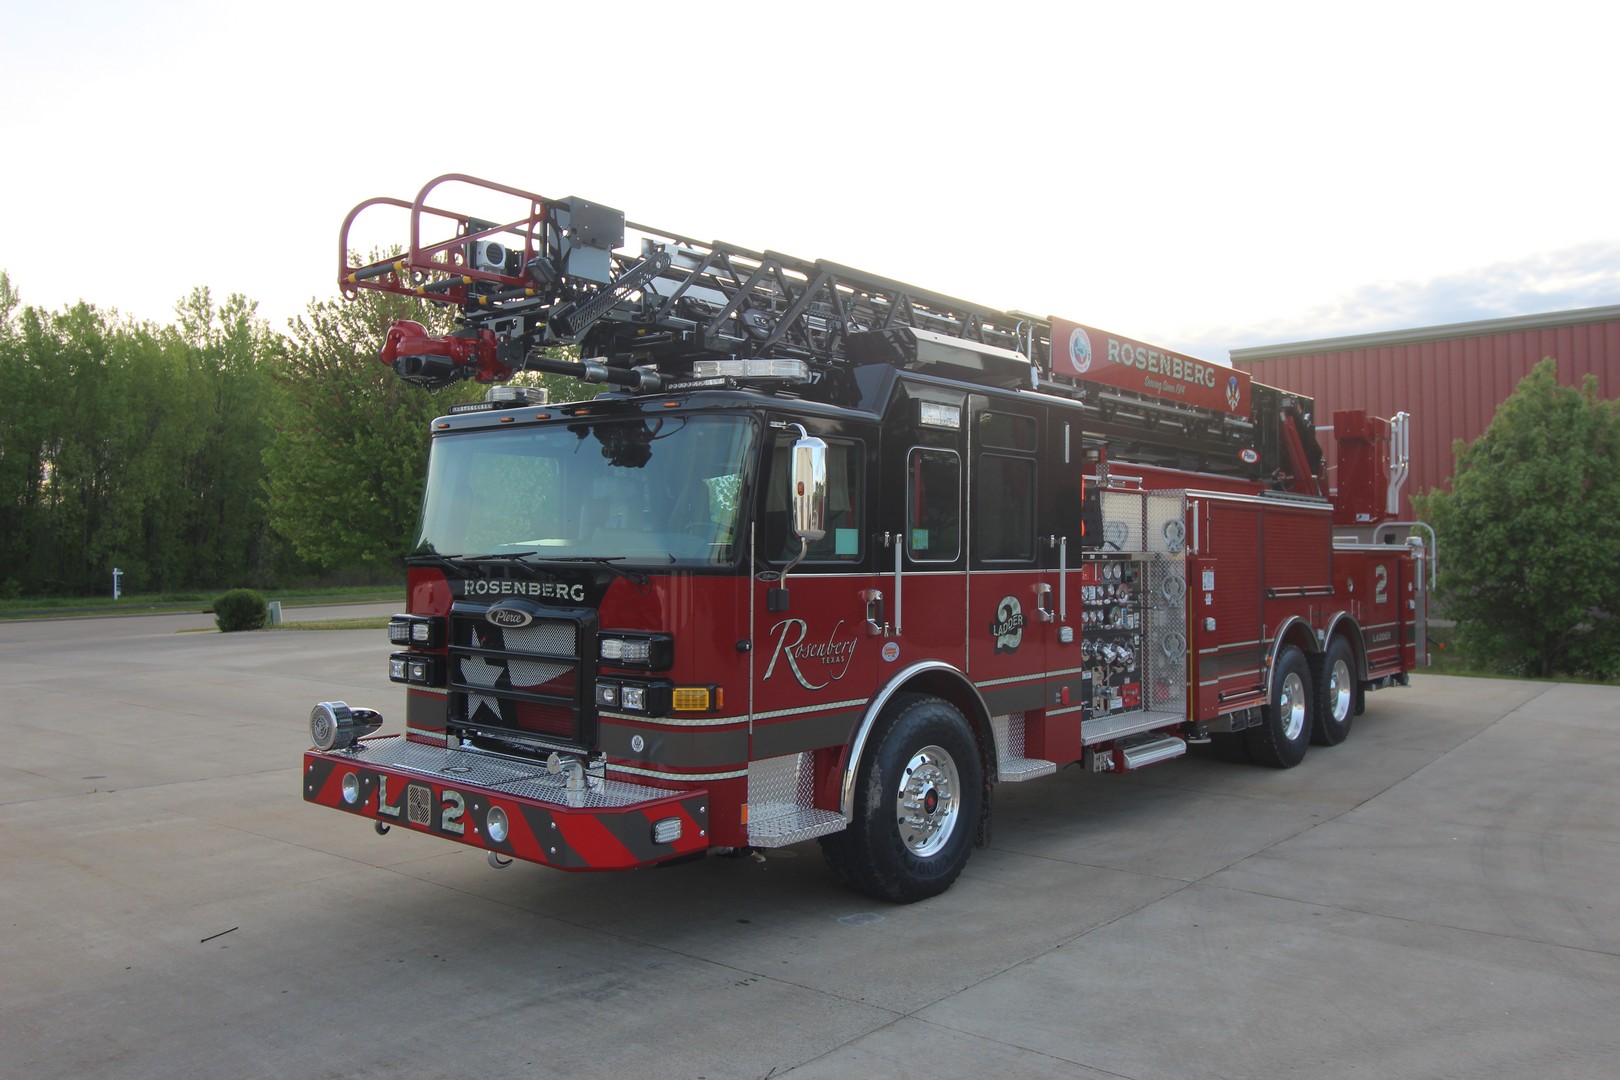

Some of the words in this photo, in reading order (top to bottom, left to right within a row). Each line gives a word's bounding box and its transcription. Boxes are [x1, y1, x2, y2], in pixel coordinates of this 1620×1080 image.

[1107, 338, 1215, 388] ROSENBERG
[463, 579, 586, 602] ROSENBERG
[1375, 564, 1387, 604] 2
[495, 610, 522, 623] Pierce
[993, 614, 1023, 636] LADDER
[763, 618, 858, 690] Rosenberg
[821, 655, 845, 664] TEXAS
[378, 774, 401, 817] L
[441, 789, 465, 835] 2
